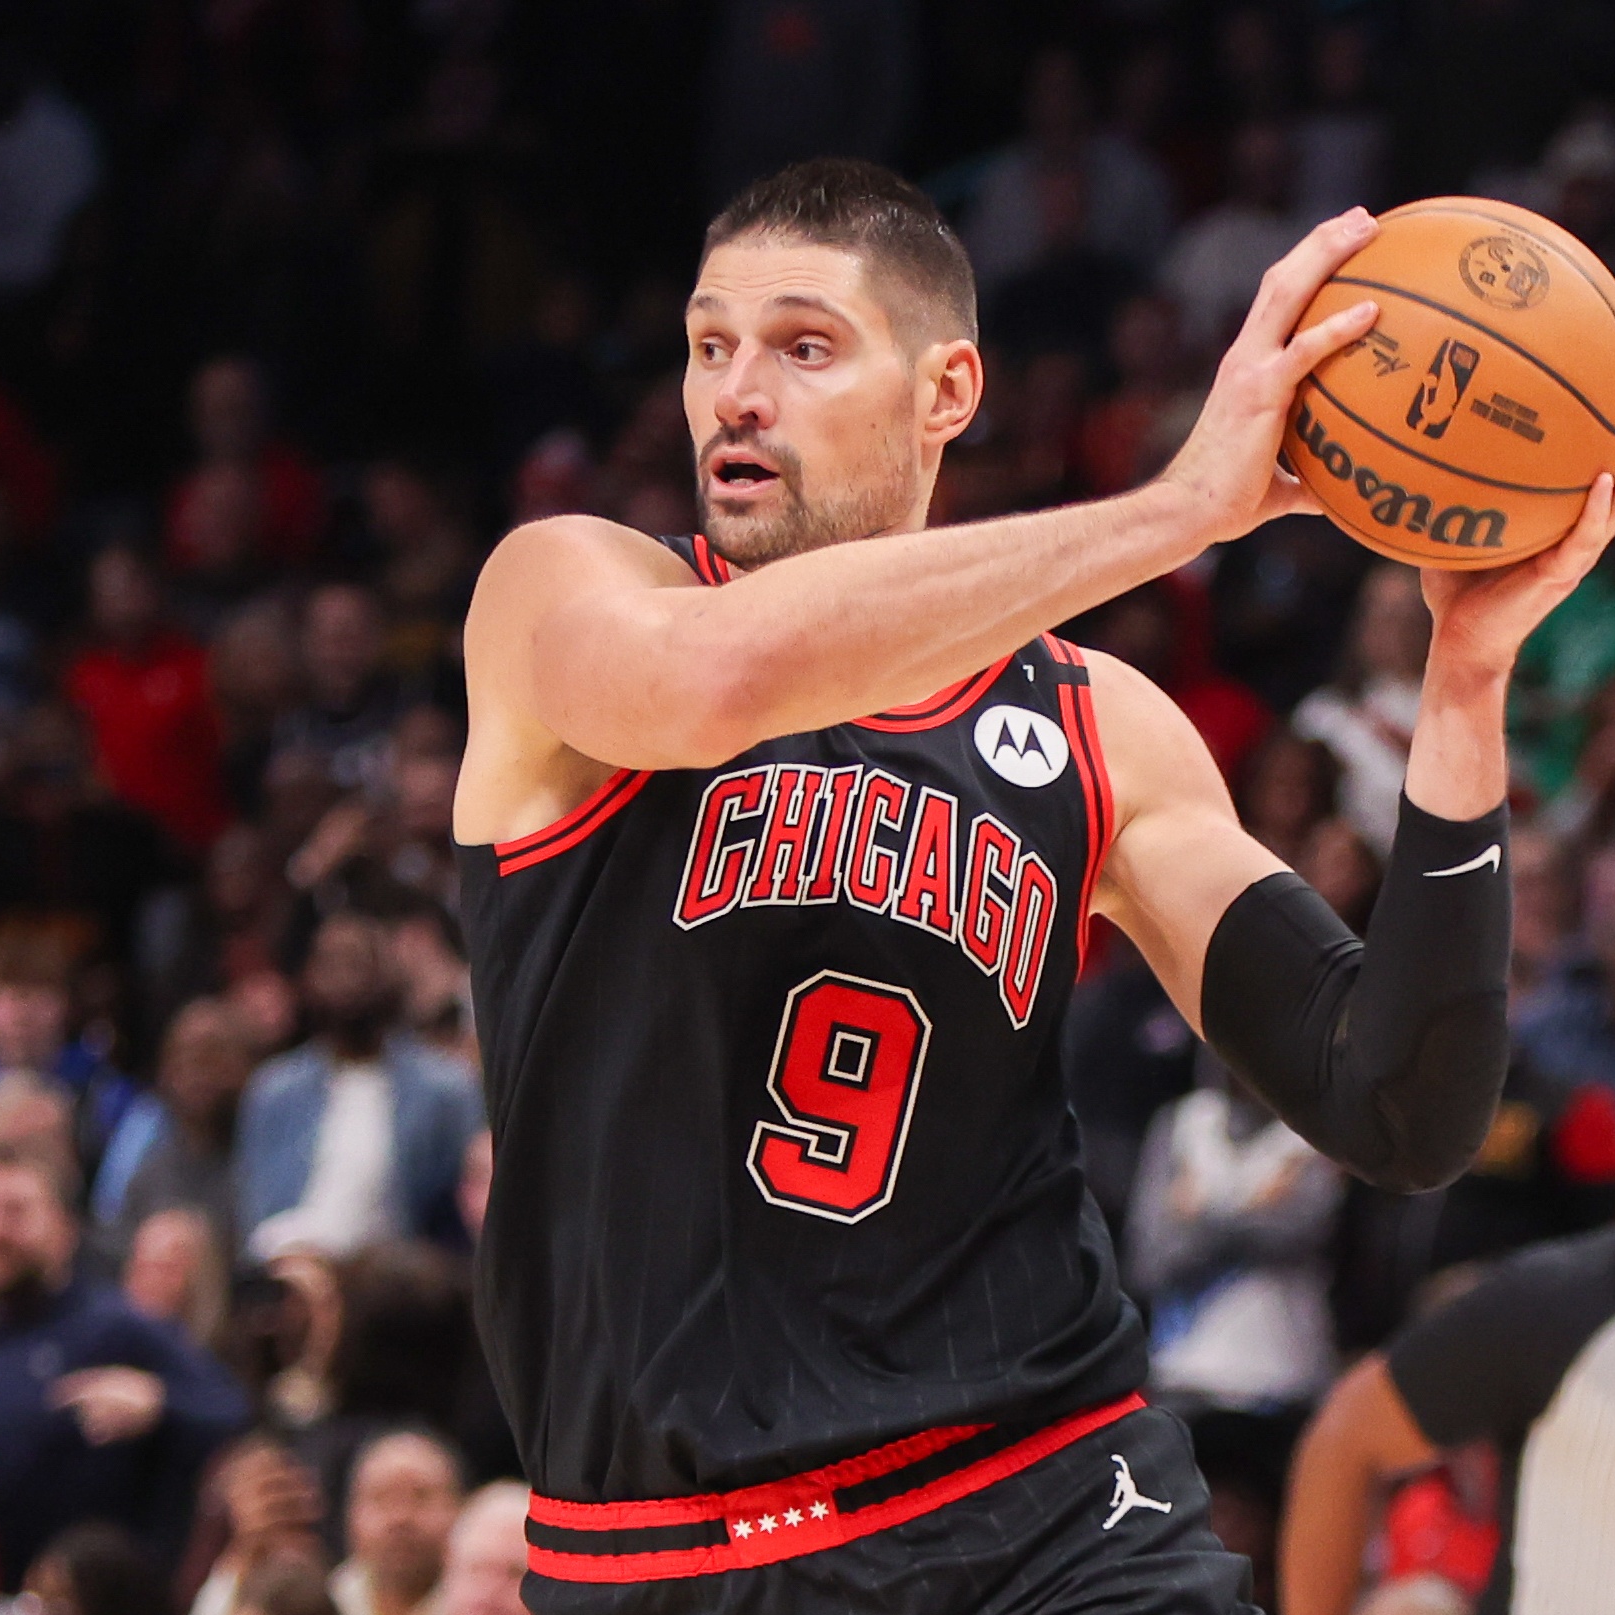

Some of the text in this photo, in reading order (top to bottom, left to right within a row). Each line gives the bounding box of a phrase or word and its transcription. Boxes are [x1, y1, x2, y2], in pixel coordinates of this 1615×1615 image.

[1295, 402, 1508, 547] Wilson
[672, 763, 1058, 1031] CHICAGO
[746, 968, 932, 1226] 9
